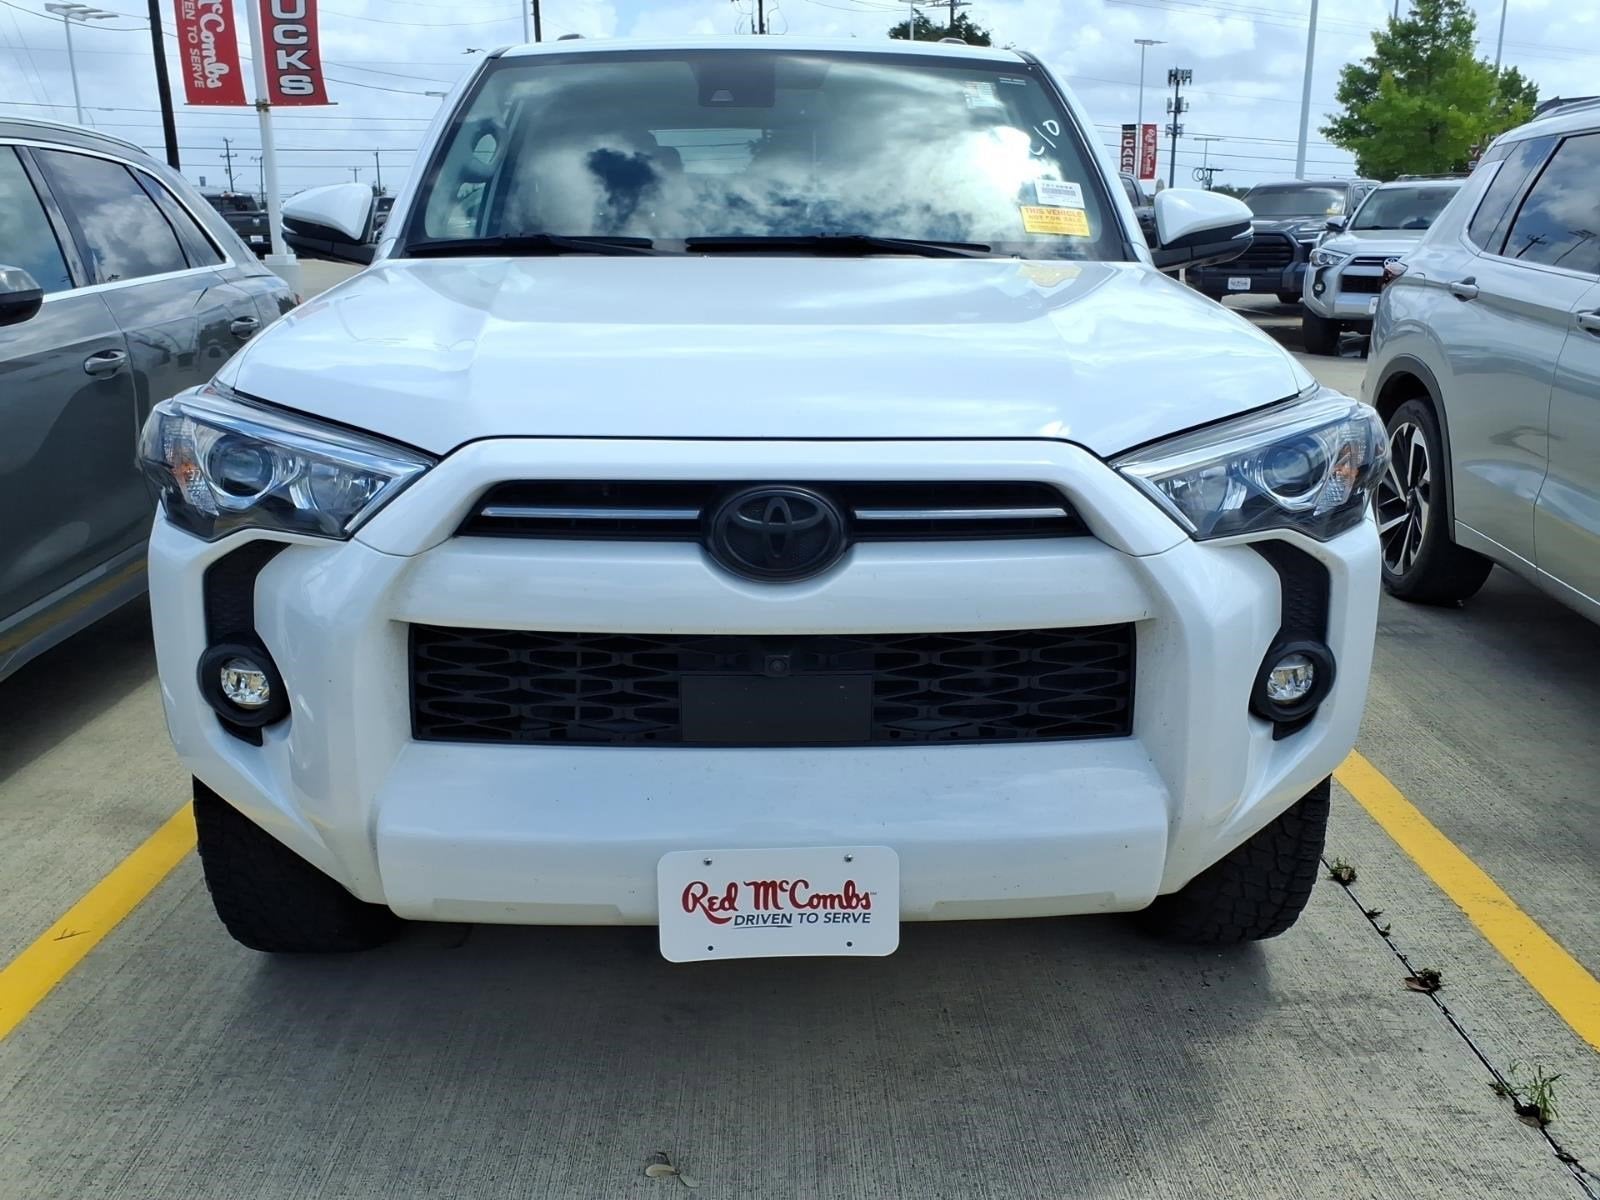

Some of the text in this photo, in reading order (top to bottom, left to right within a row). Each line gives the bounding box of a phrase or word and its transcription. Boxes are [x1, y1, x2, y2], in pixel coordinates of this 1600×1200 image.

[184, 0, 205, 88] EN TO SERVE
[271, 0, 314, 94] UCKS
[1122, 138, 1135, 173] CARS
[1046, 208, 1082, 217] VEHICLE
[681, 879, 872, 925] Red McCombs
[734, 911, 872, 927] DRIVEN TO SERVE
